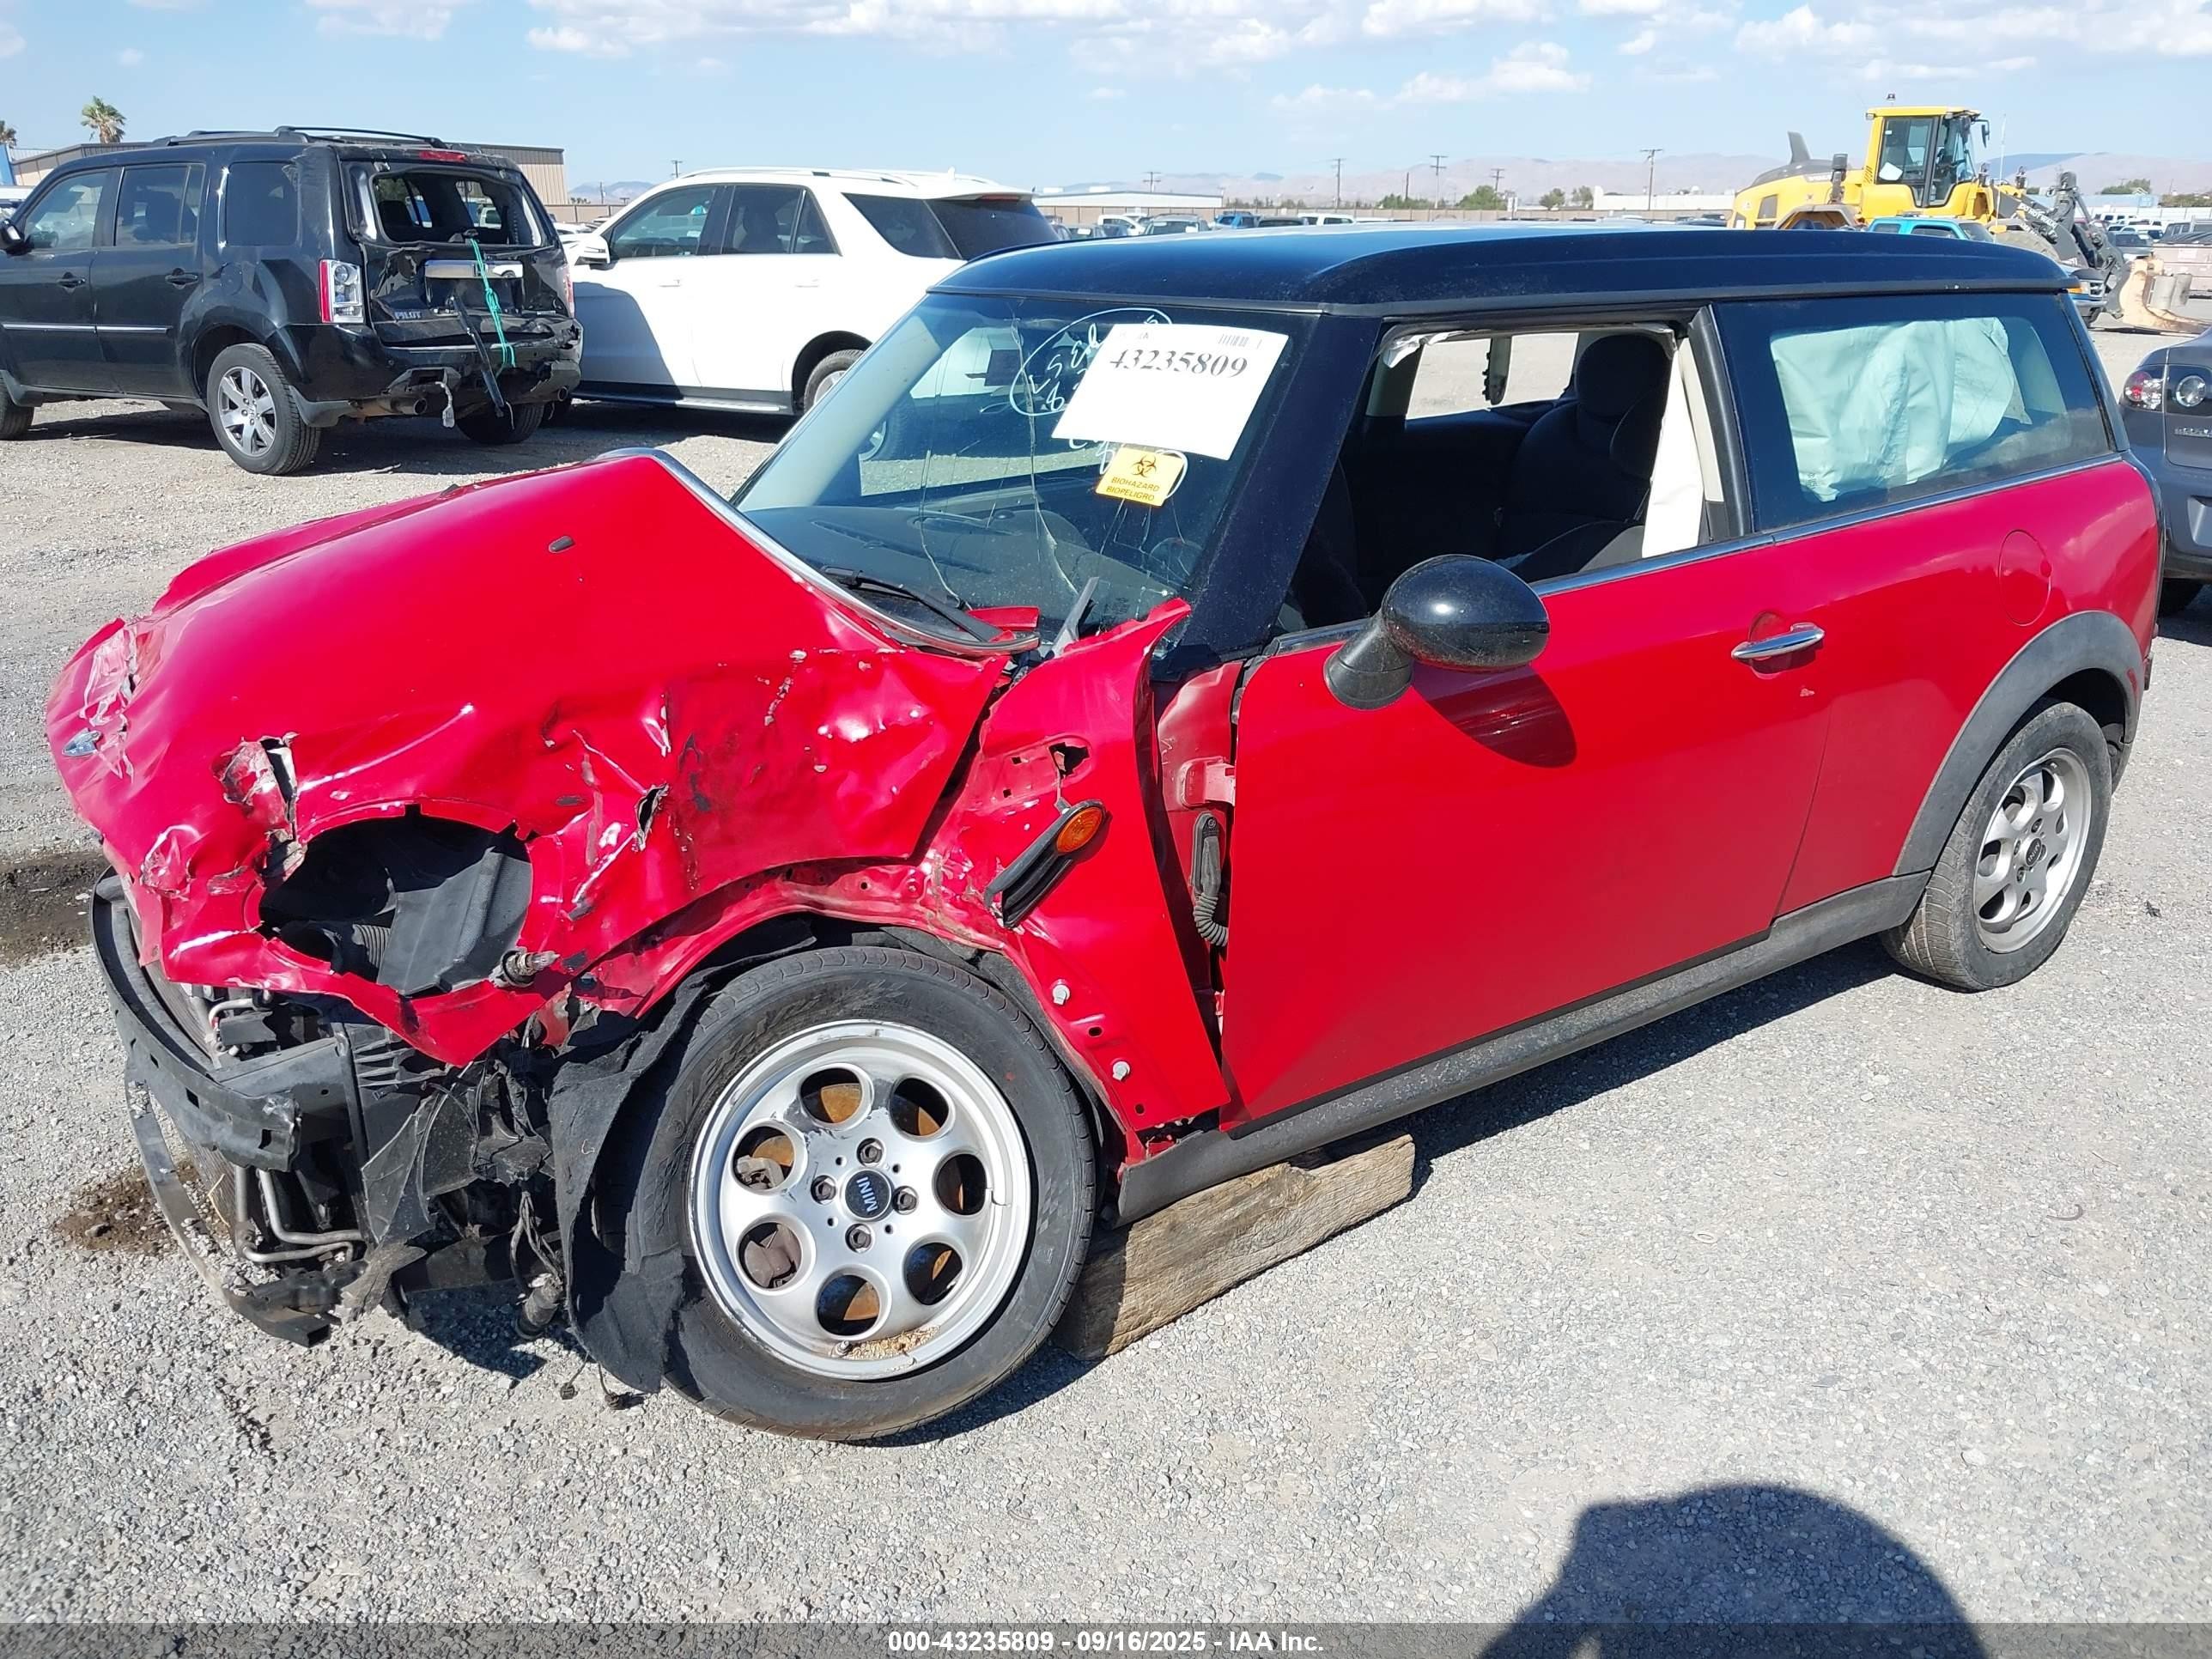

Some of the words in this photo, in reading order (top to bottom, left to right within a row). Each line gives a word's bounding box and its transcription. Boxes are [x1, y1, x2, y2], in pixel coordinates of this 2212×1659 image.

[395, 310, 422, 319] PILOT
[1110, 349, 1248, 378] 43235809
[1111, 477, 1160, 492] BIOHAZARD
[1106, 486, 1155, 501] BIOPELIGRO
[2027, 842, 2041, 862] MINI
[856, 1176, 878, 1212] MINI
